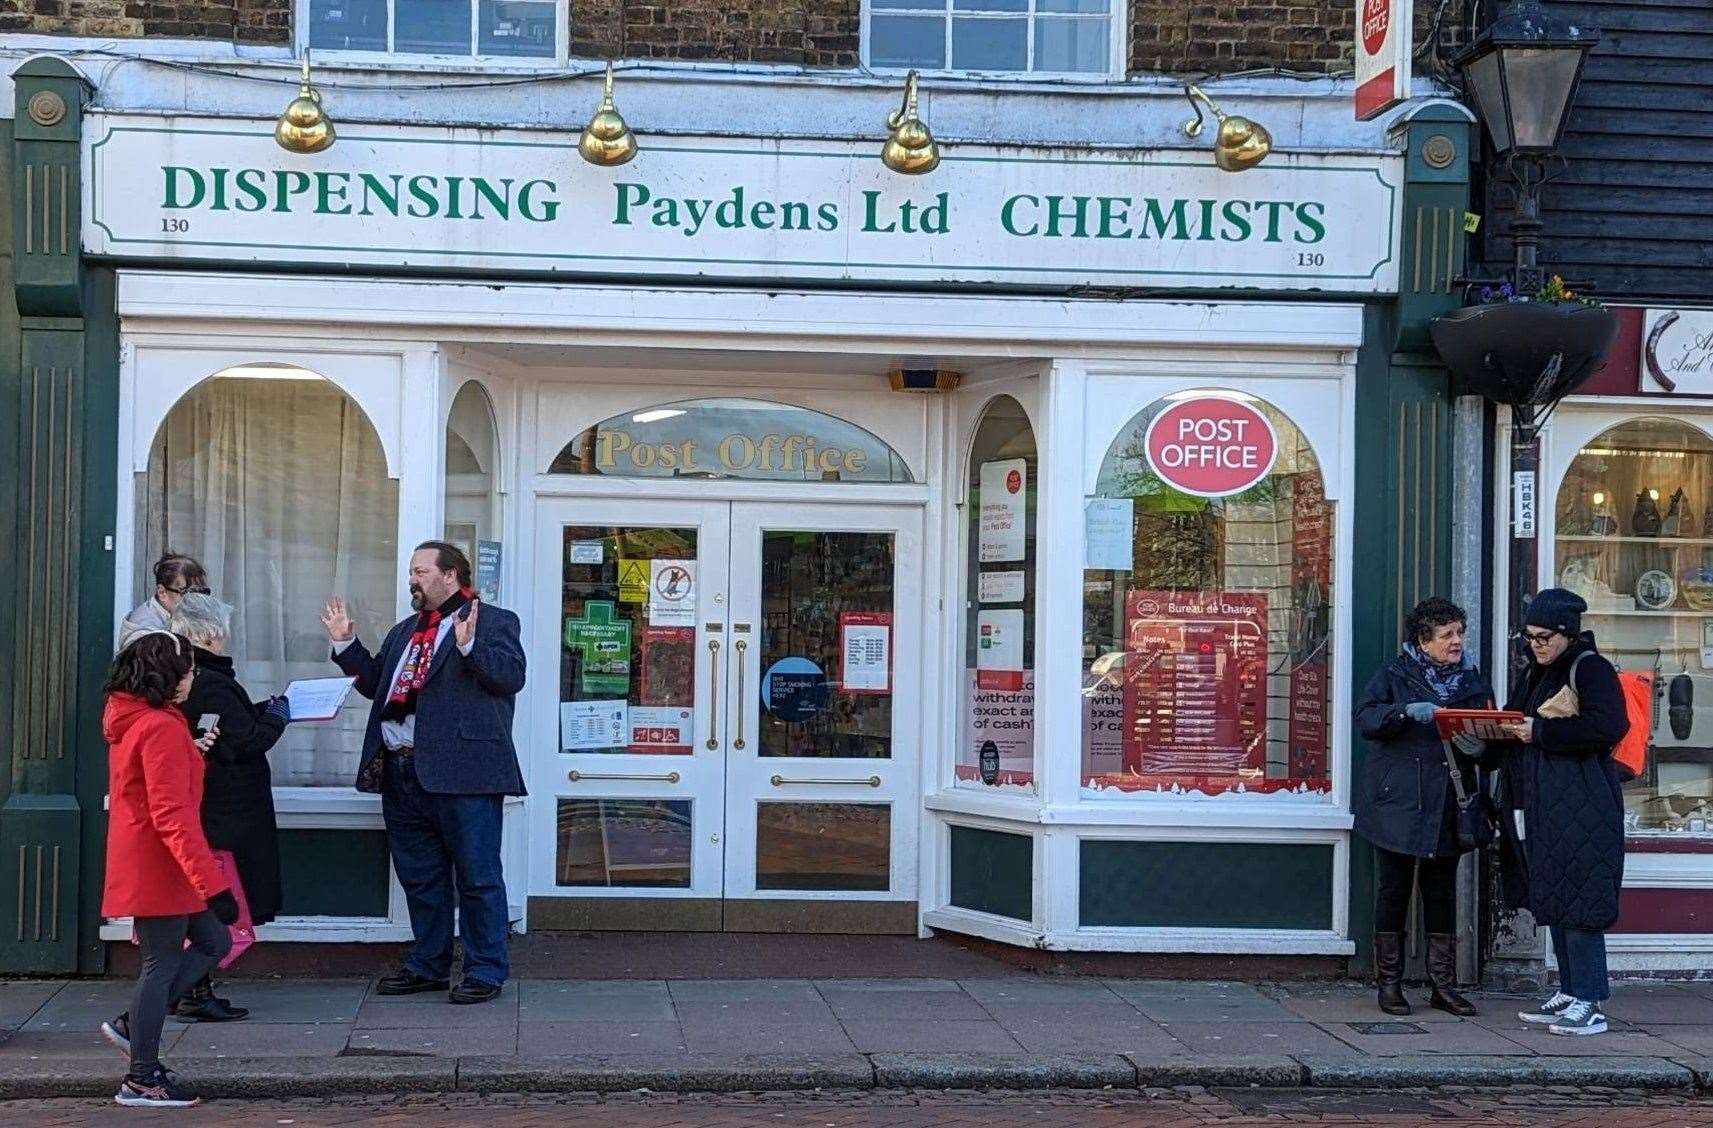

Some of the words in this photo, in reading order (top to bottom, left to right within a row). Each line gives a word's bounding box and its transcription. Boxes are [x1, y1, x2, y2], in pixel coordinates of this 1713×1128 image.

[162, 166, 560, 222] DISPENSING
[613, 182, 838, 237] Paydens
[861, 190, 951, 236] Ltd
[1001, 194, 1327, 245] CHEMISTS
[162, 218, 189, 233] 130
[1298, 253, 1324, 267] 130
[1179, 418, 1249, 442] POST
[598, 430, 696, 469] Post
[718, 432, 867, 473] Office
[1161, 445, 1258, 468] OFFICE
[1168, 602, 1204, 614] Bureau
[1206, 602, 1219, 614] de
[1221, 603, 1258, 617] Change
[1091, 695, 1124, 705] with
[972, 706, 1017, 716] exact
[973, 718, 990, 729] of
